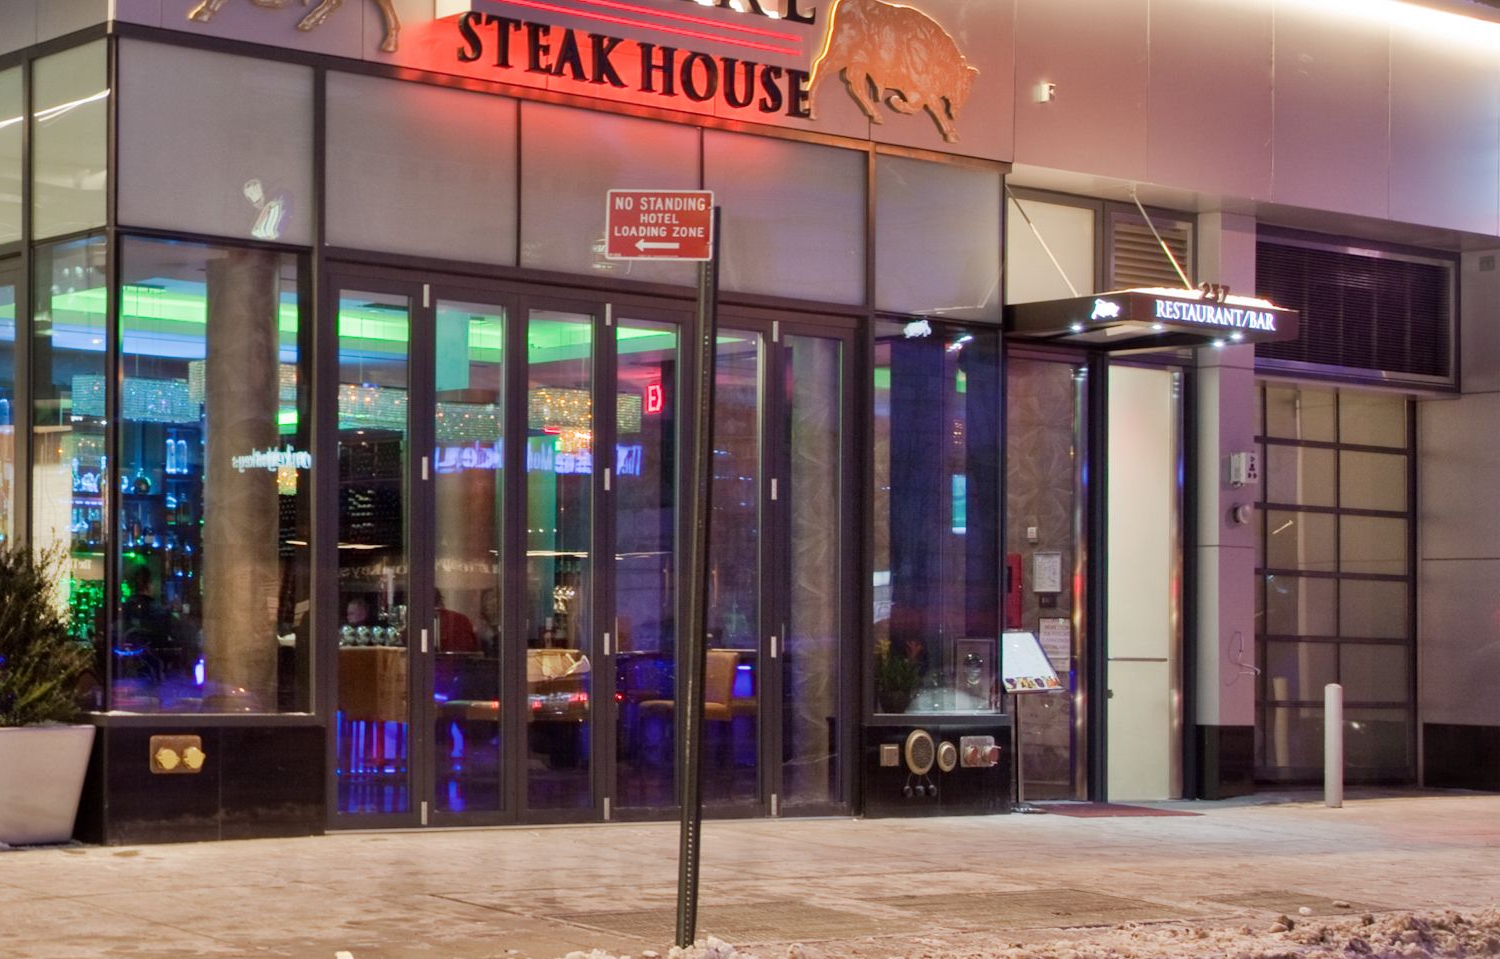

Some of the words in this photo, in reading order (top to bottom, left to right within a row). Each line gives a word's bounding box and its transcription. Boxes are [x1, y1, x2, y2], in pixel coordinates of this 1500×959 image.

[457, 11, 625, 89] STEAK
[637, 41, 812, 118] HOUSE
[615, 197, 633, 211] NO
[640, 197, 706, 211] STANDING
[640, 213, 680, 224] HOTEL
[614, 226, 667, 237] LOADING
[672, 227, 705, 238] ZONE
[1156, 300, 1277, 331] RESTAURANT/BAR
